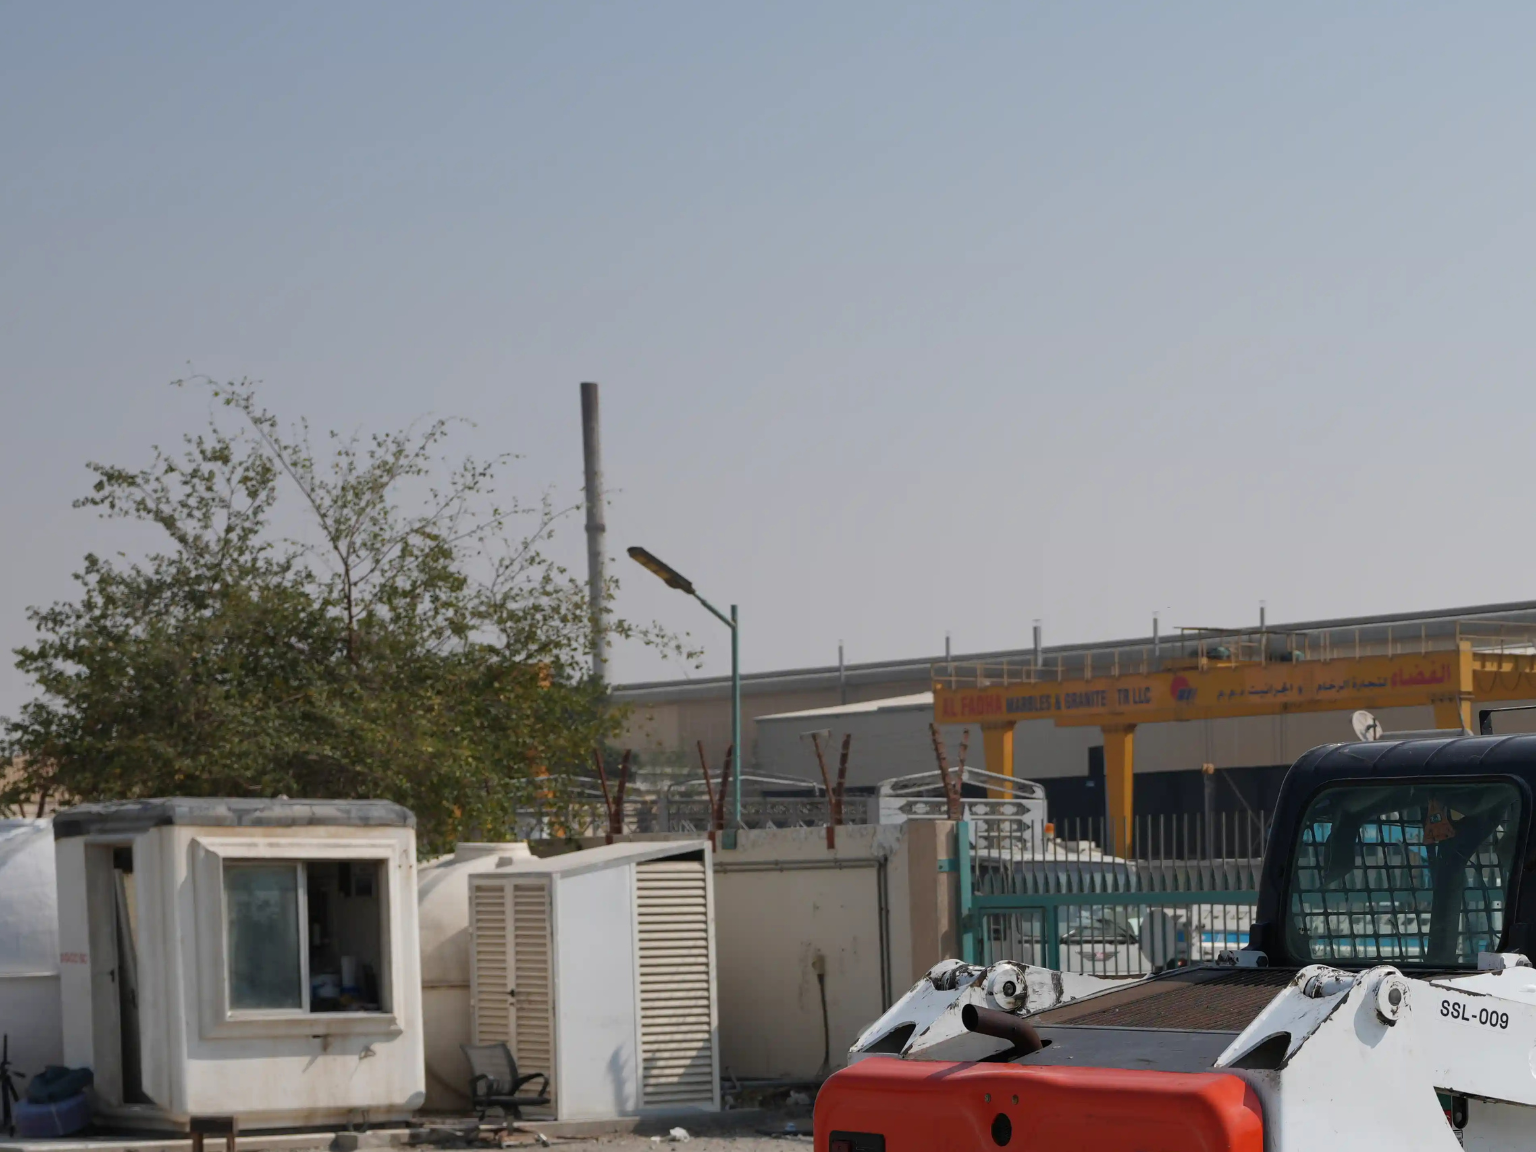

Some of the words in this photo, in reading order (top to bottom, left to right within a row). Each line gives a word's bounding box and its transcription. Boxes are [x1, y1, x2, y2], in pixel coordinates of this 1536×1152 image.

[1064, 689, 1107, 708] GRANITE
[1133, 686, 1151, 705] LLC
[1440, 999, 1509, 1030] SSL-009
